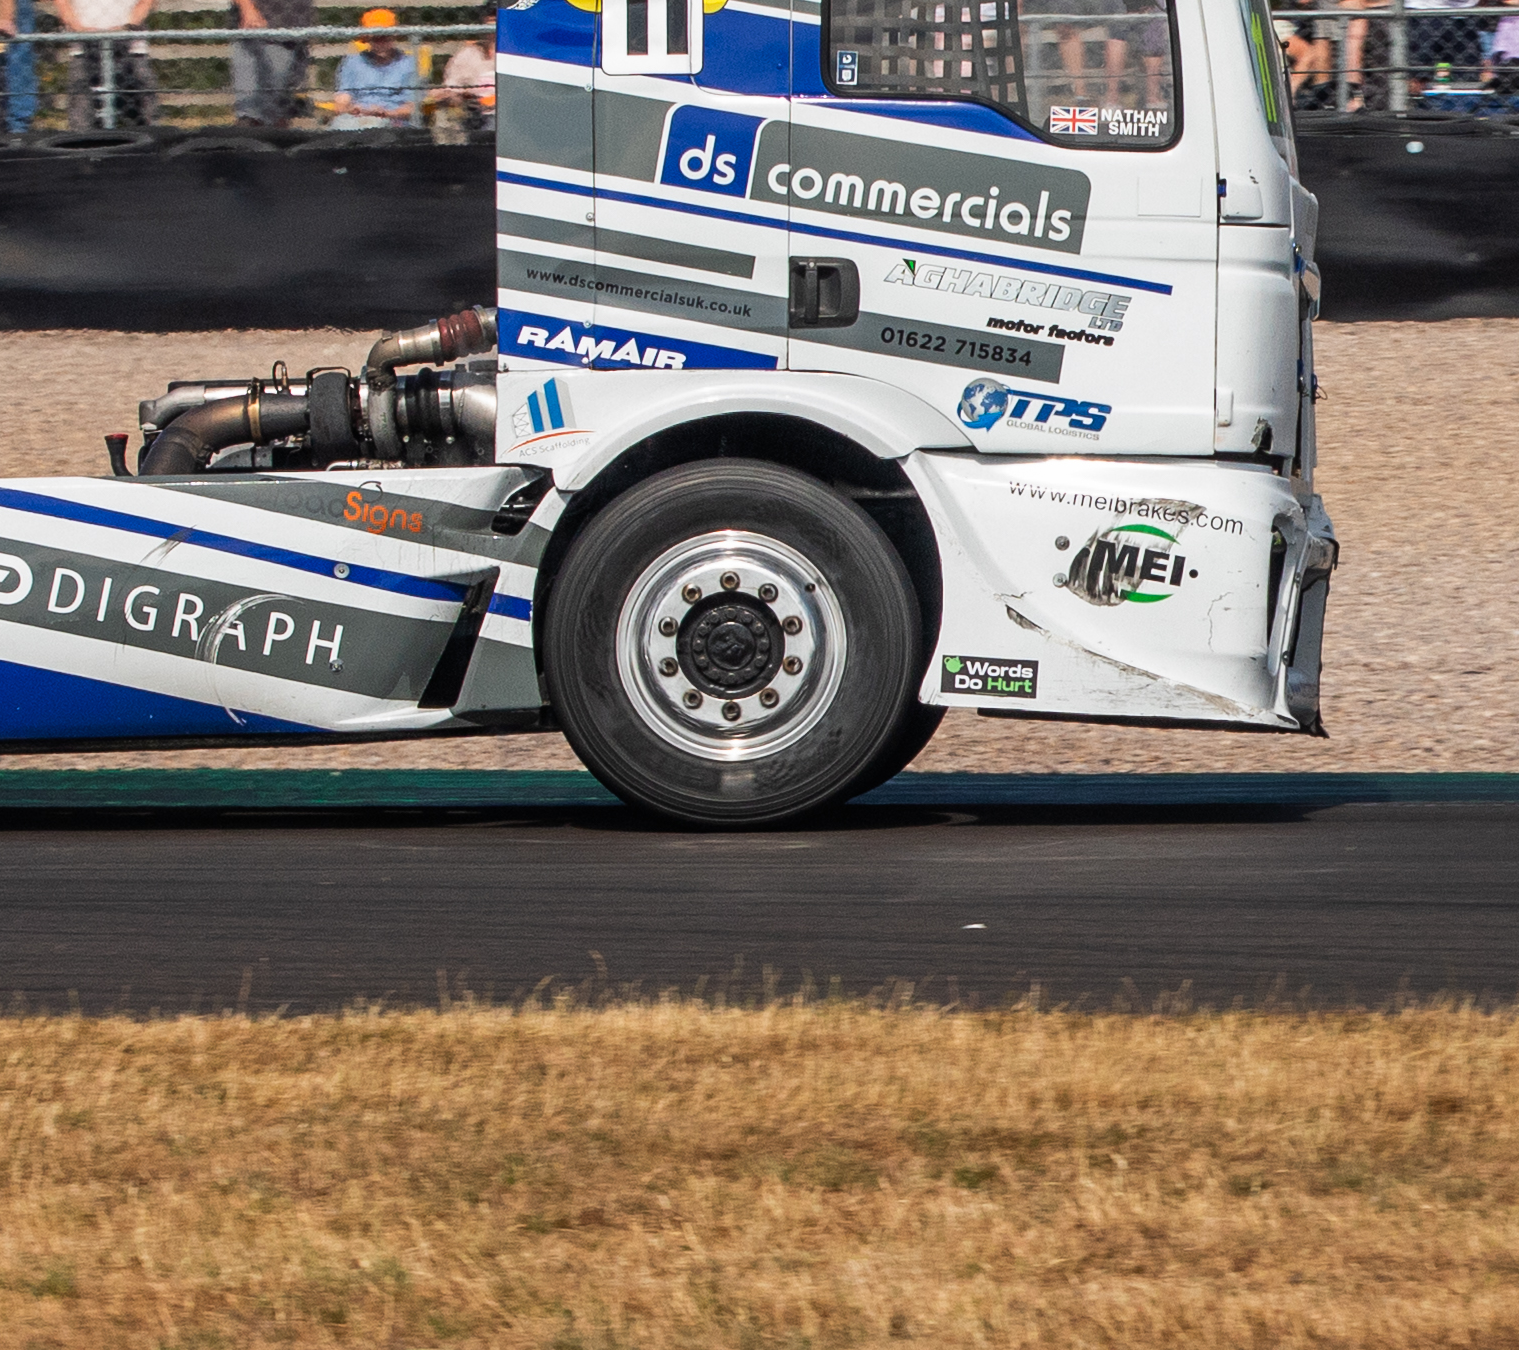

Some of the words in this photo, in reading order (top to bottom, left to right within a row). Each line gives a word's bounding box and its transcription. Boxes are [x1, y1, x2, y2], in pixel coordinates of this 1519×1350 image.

[1101, 108, 1168, 125] NATHAN
[1108, 121, 1160, 137] SMITH
[679, 134, 737, 186] ds
[767, 163, 1073, 242] commercials
[526, 268, 752, 318] www.dscommercialsuk.co.uk
[884, 259, 1133, 320] AGHABRIDGE
[986, 317, 1045, 335] motor
[1088, 317, 1124, 333] LTD
[517, 325, 687, 370] RAMAIR
[881, 327, 947, 352] 01622
[955, 338, 1033, 367] 715834
[1006, 419, 1046, 433] GLOBAL
[1047, 425, 1100, 441] LOGISTICS
[519, 446, 538, 458] ACS
[539, 437, 591, 453] Scaffolding
[1009, 481, 1244, 536] www.meibrakes.com
[1089, 537, 1187, 588] MEI
[47, 566, 344, 665] DIGRAPH
[954, 675, 983, 690] Do
[987, 677, 1033, 693] Hurt
[966, 660, 1034, 679] Words
